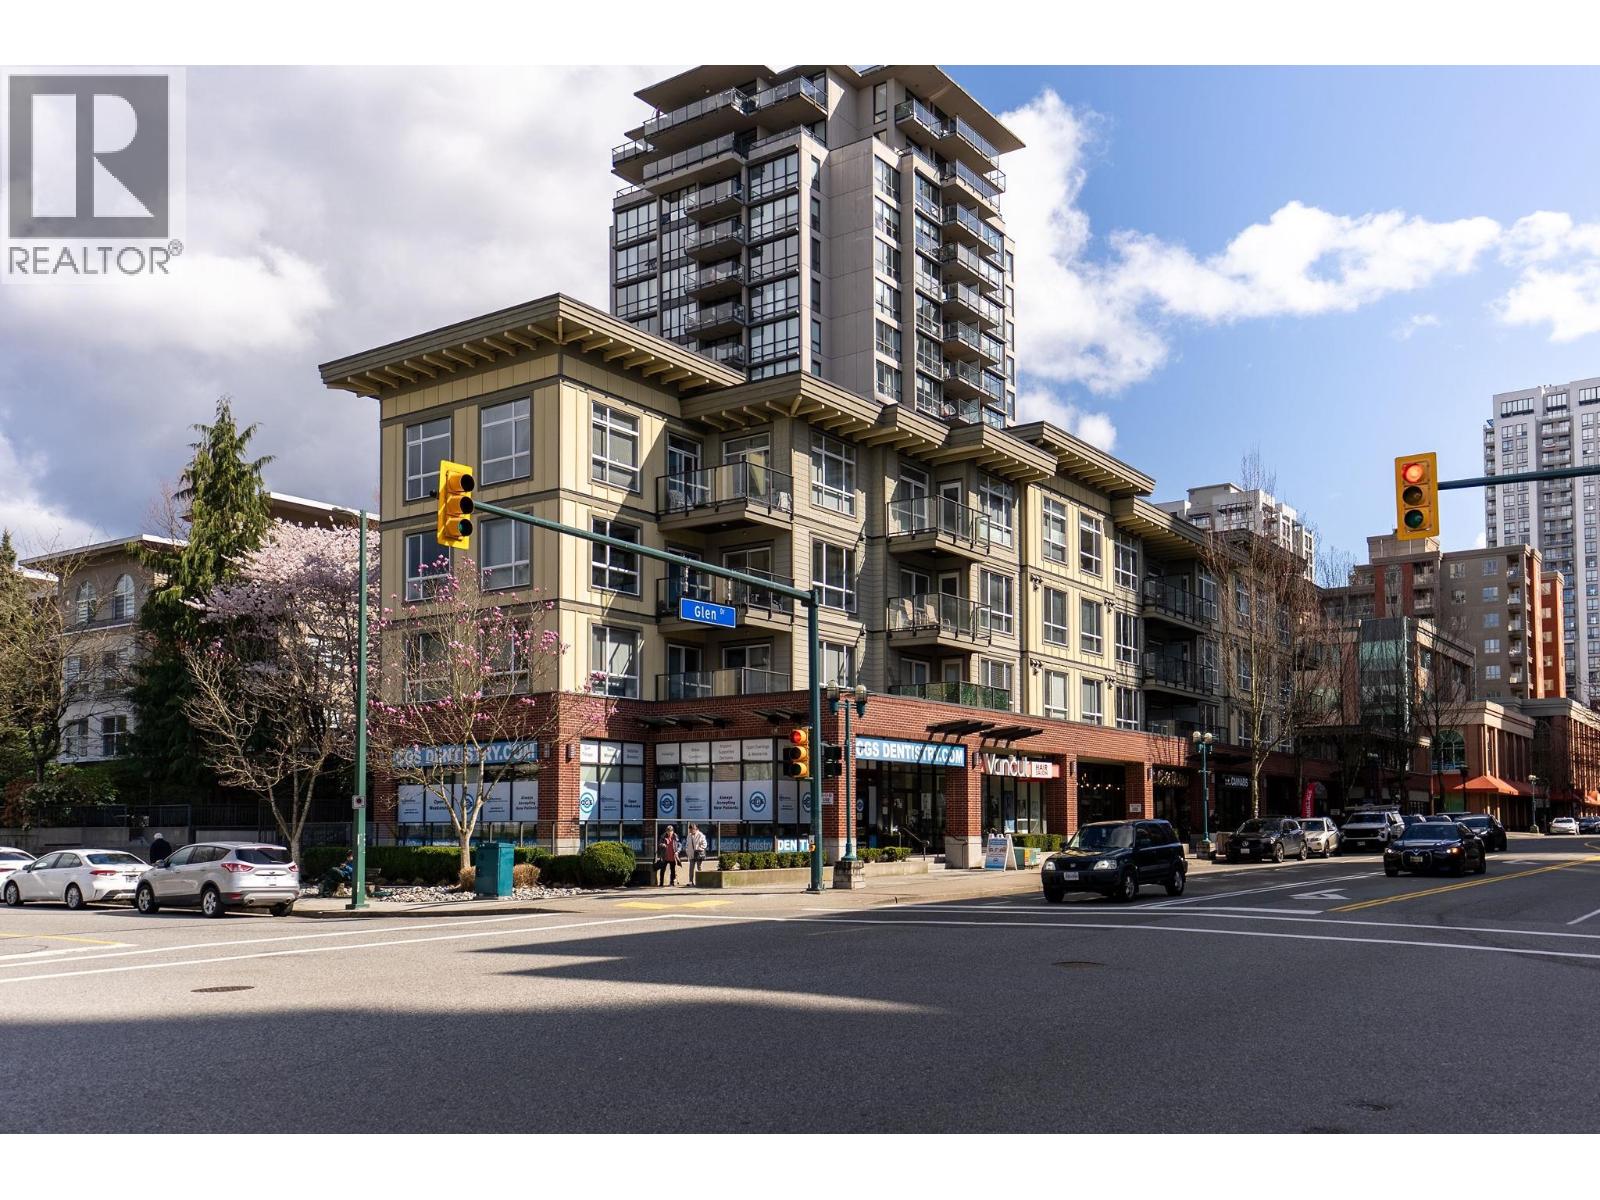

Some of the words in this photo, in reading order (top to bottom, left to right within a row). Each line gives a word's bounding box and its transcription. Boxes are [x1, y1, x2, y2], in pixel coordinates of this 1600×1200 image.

[695, 606, 716, 620] Glen
[856, 741, 880, 757] CGS
[882, 743, 964, 764] DENTISTRY.COM
